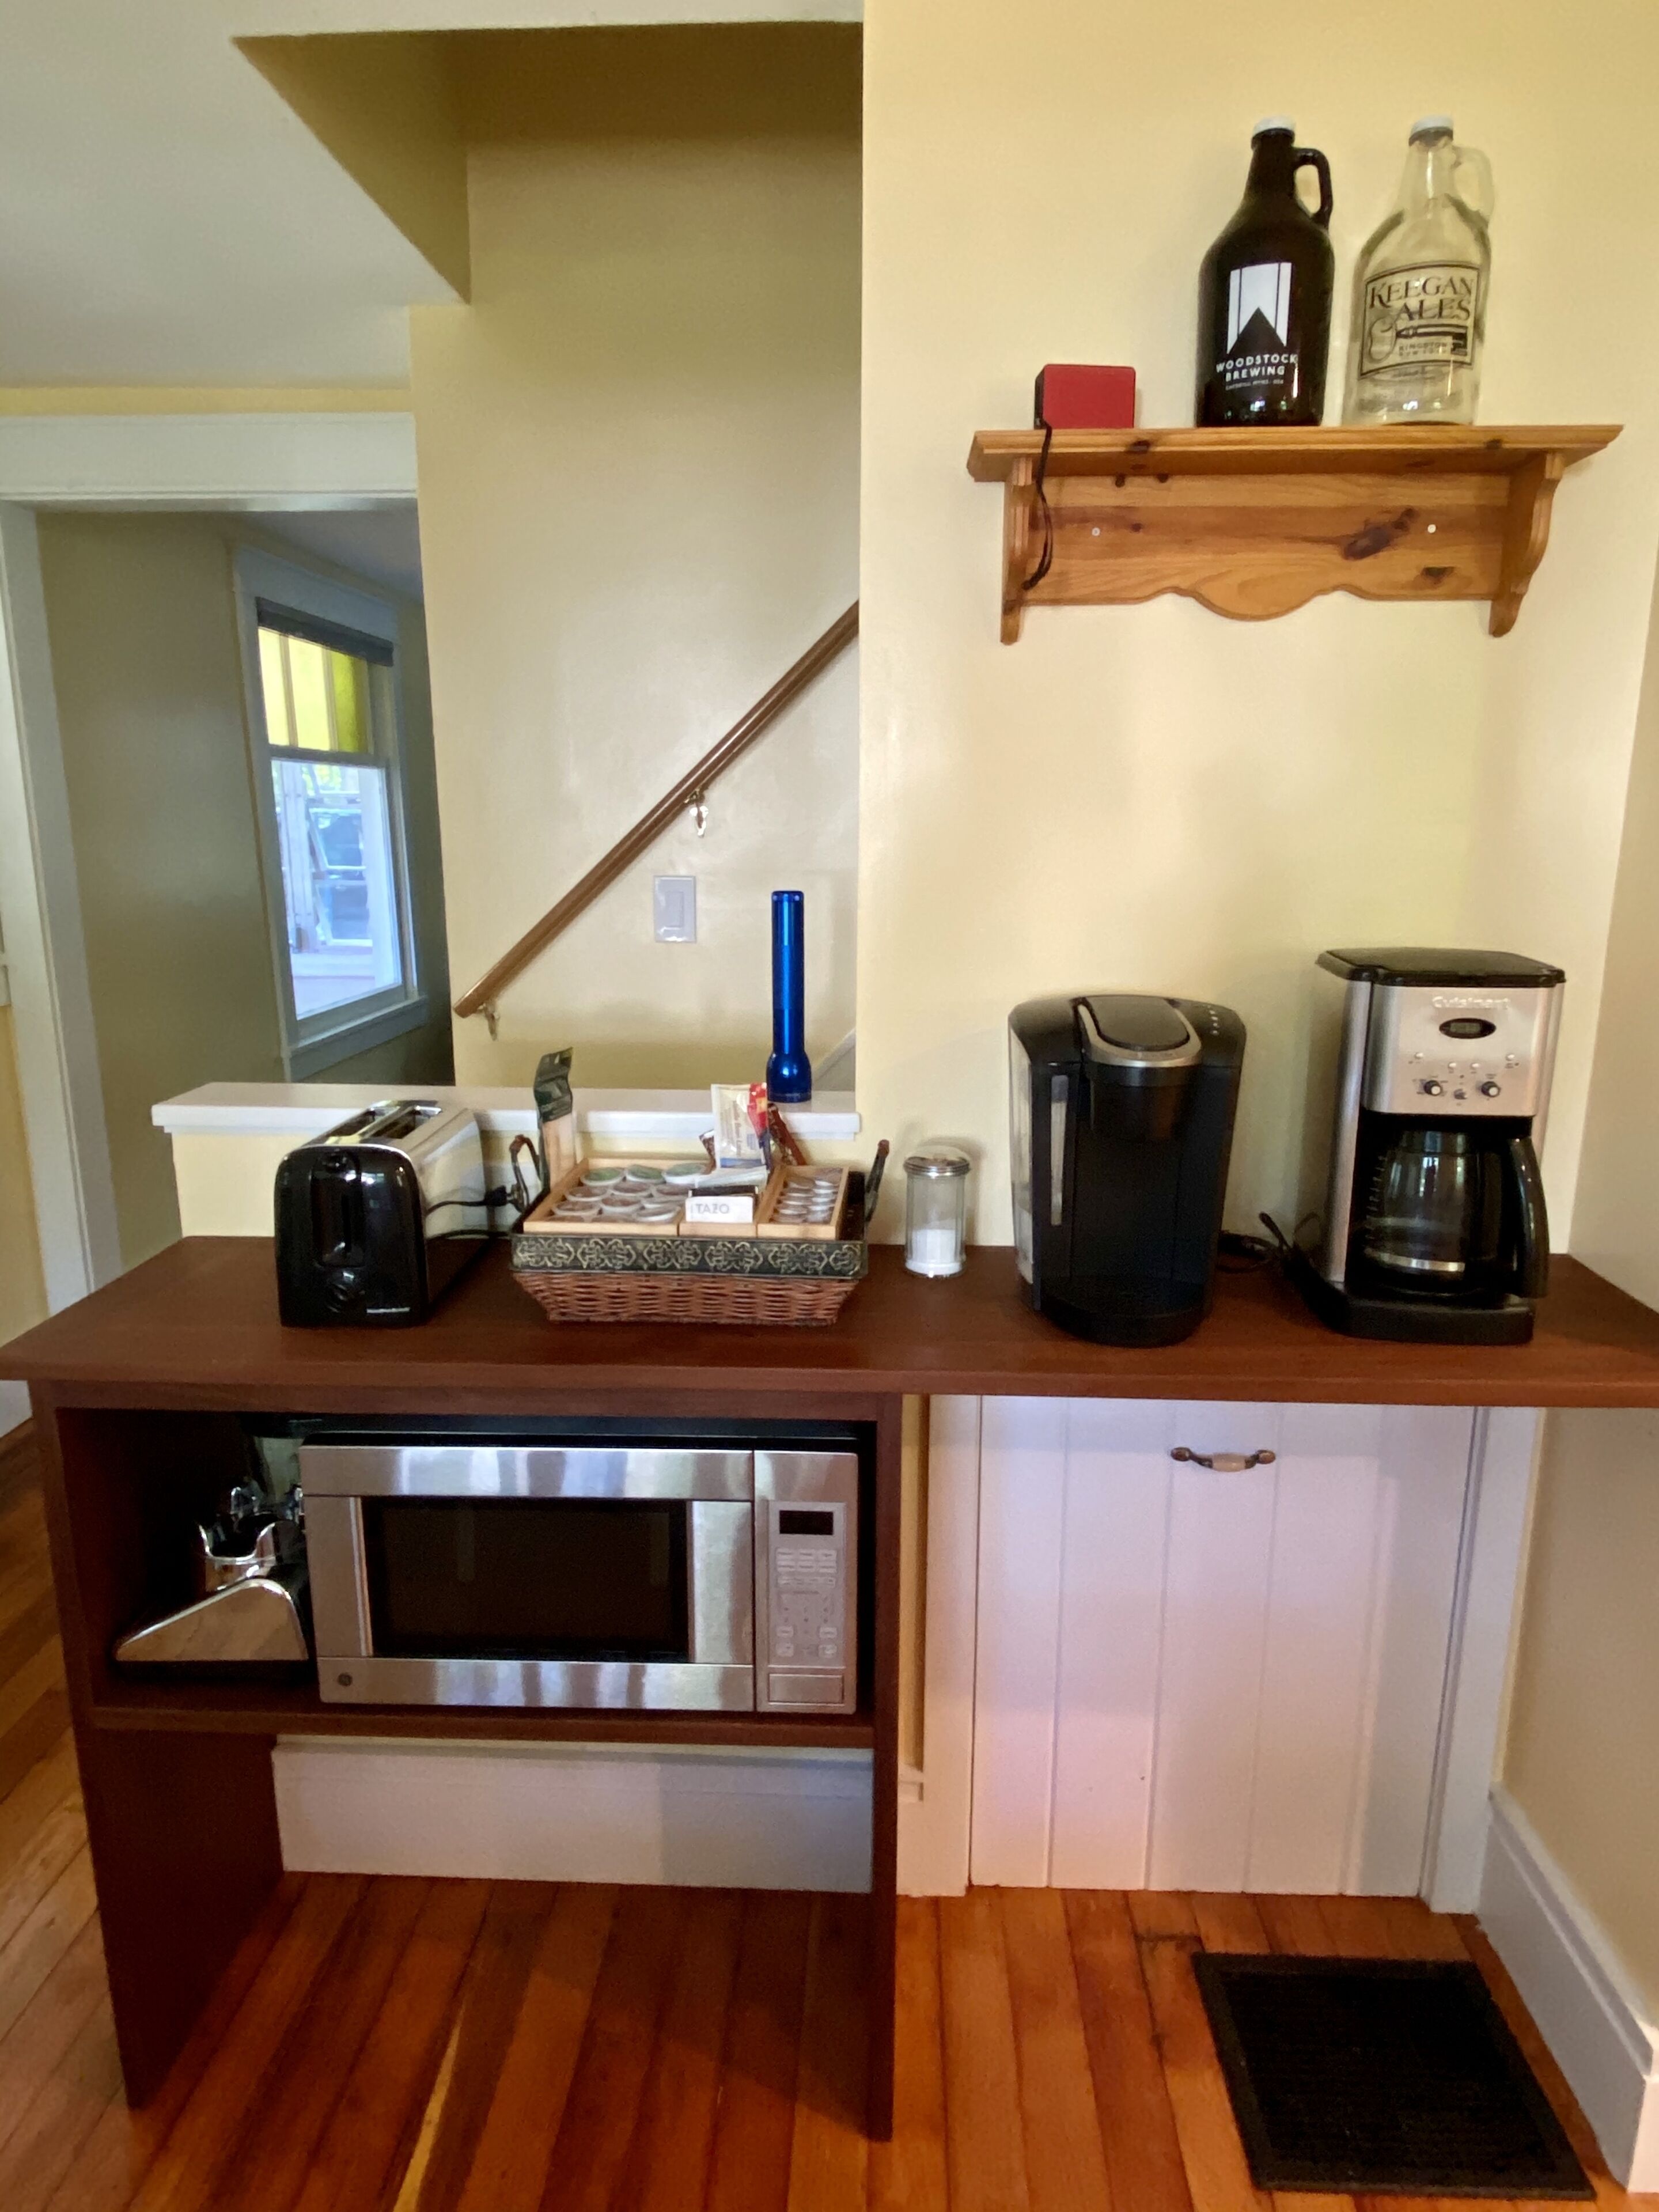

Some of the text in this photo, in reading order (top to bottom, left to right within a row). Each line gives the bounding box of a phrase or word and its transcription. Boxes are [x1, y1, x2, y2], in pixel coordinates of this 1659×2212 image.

[1369, 276, 1474, 309] KEEGAN
[1395, 298, 1471, 321] ALES
[1215, 354, 1298, 373] WOODSTOCK
[1225, 365, 1285, 382] BREWING
[695, 1203, 730, 1214] TAZO
